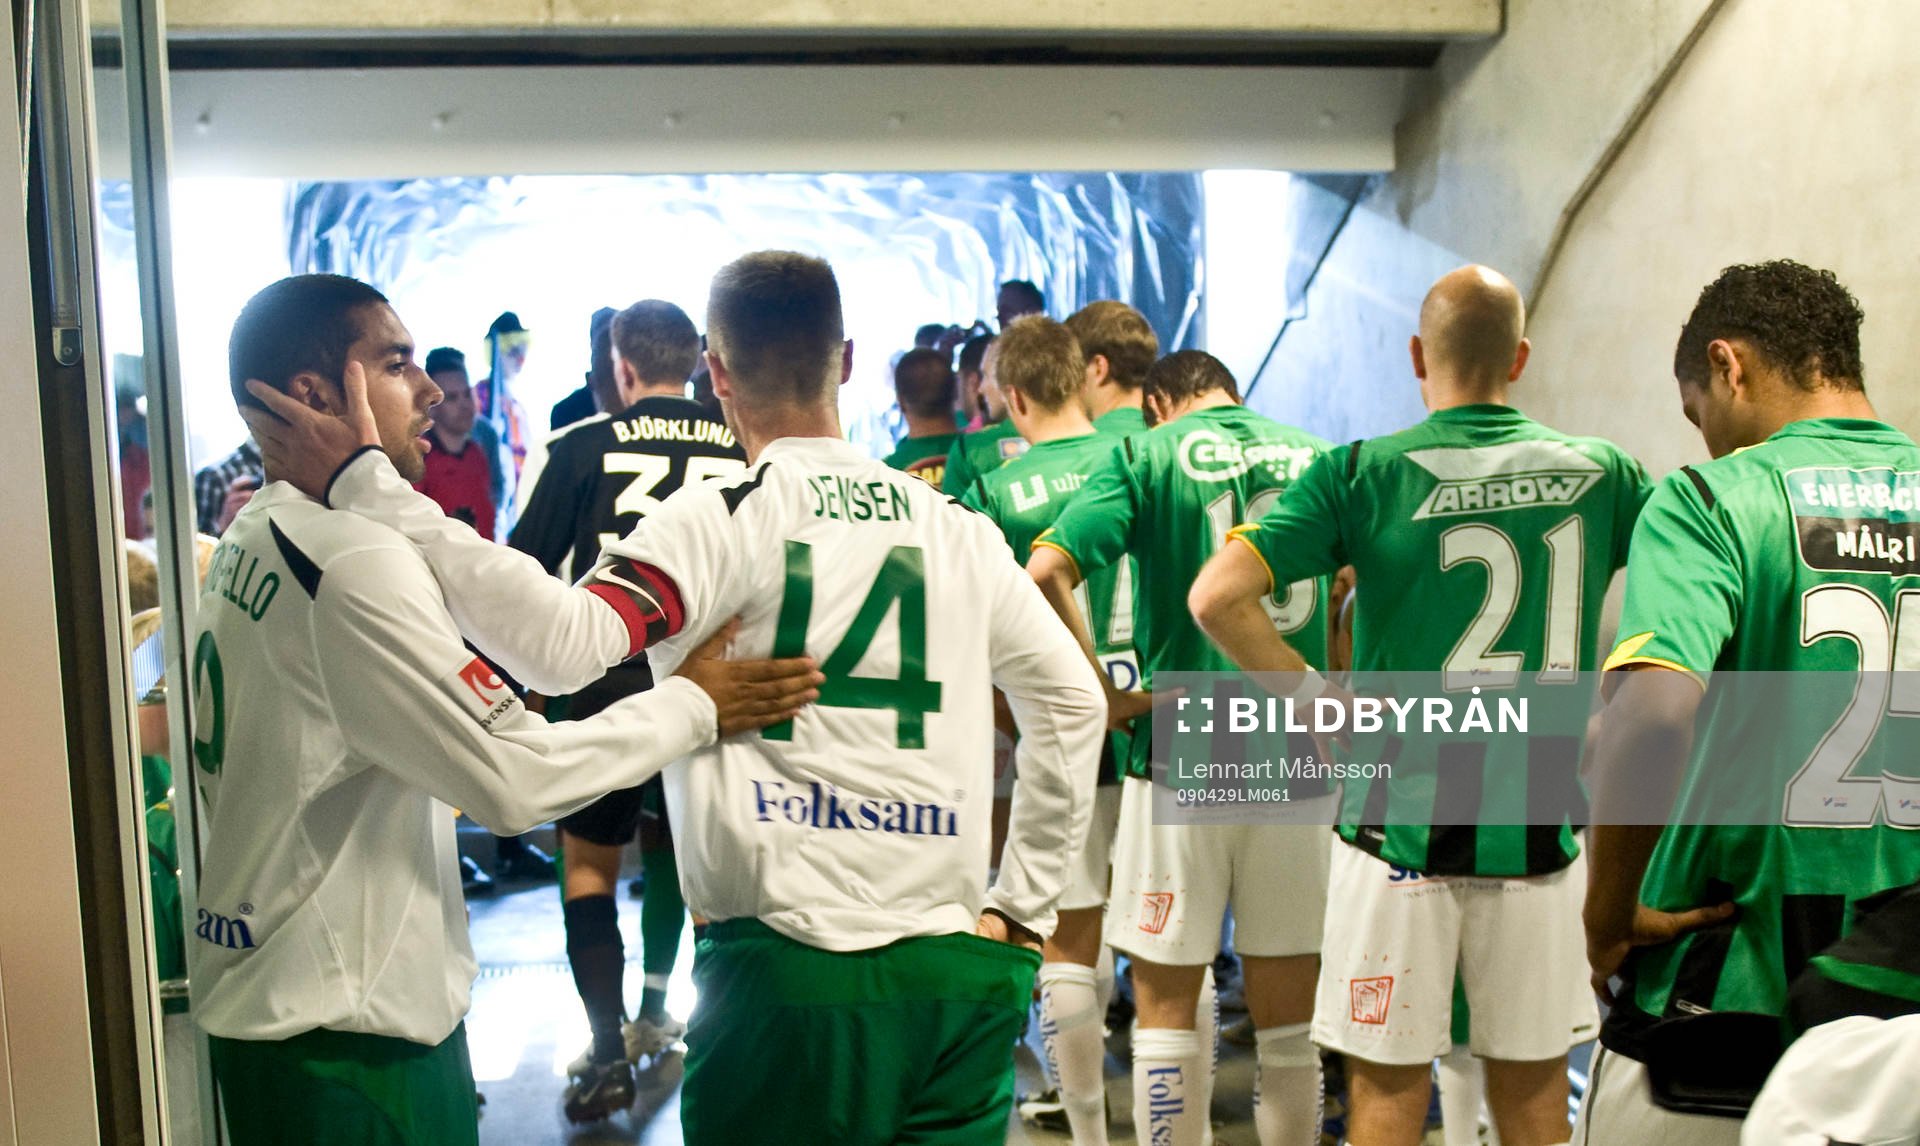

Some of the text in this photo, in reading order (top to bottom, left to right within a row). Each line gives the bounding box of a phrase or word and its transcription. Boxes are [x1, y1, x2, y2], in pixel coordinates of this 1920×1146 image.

[611, 415, 736, 448] BJÖRKLUND
[808, 475, 913, 523] JENSEN
[1432, 476, 1586, 512] ARROW
[1440, 514, 1584, 693] 21
[760, 539, 942, 750] 14
[480, 693, 518, 730] SVENSK
[751, 778, 960, 837] Folksam
